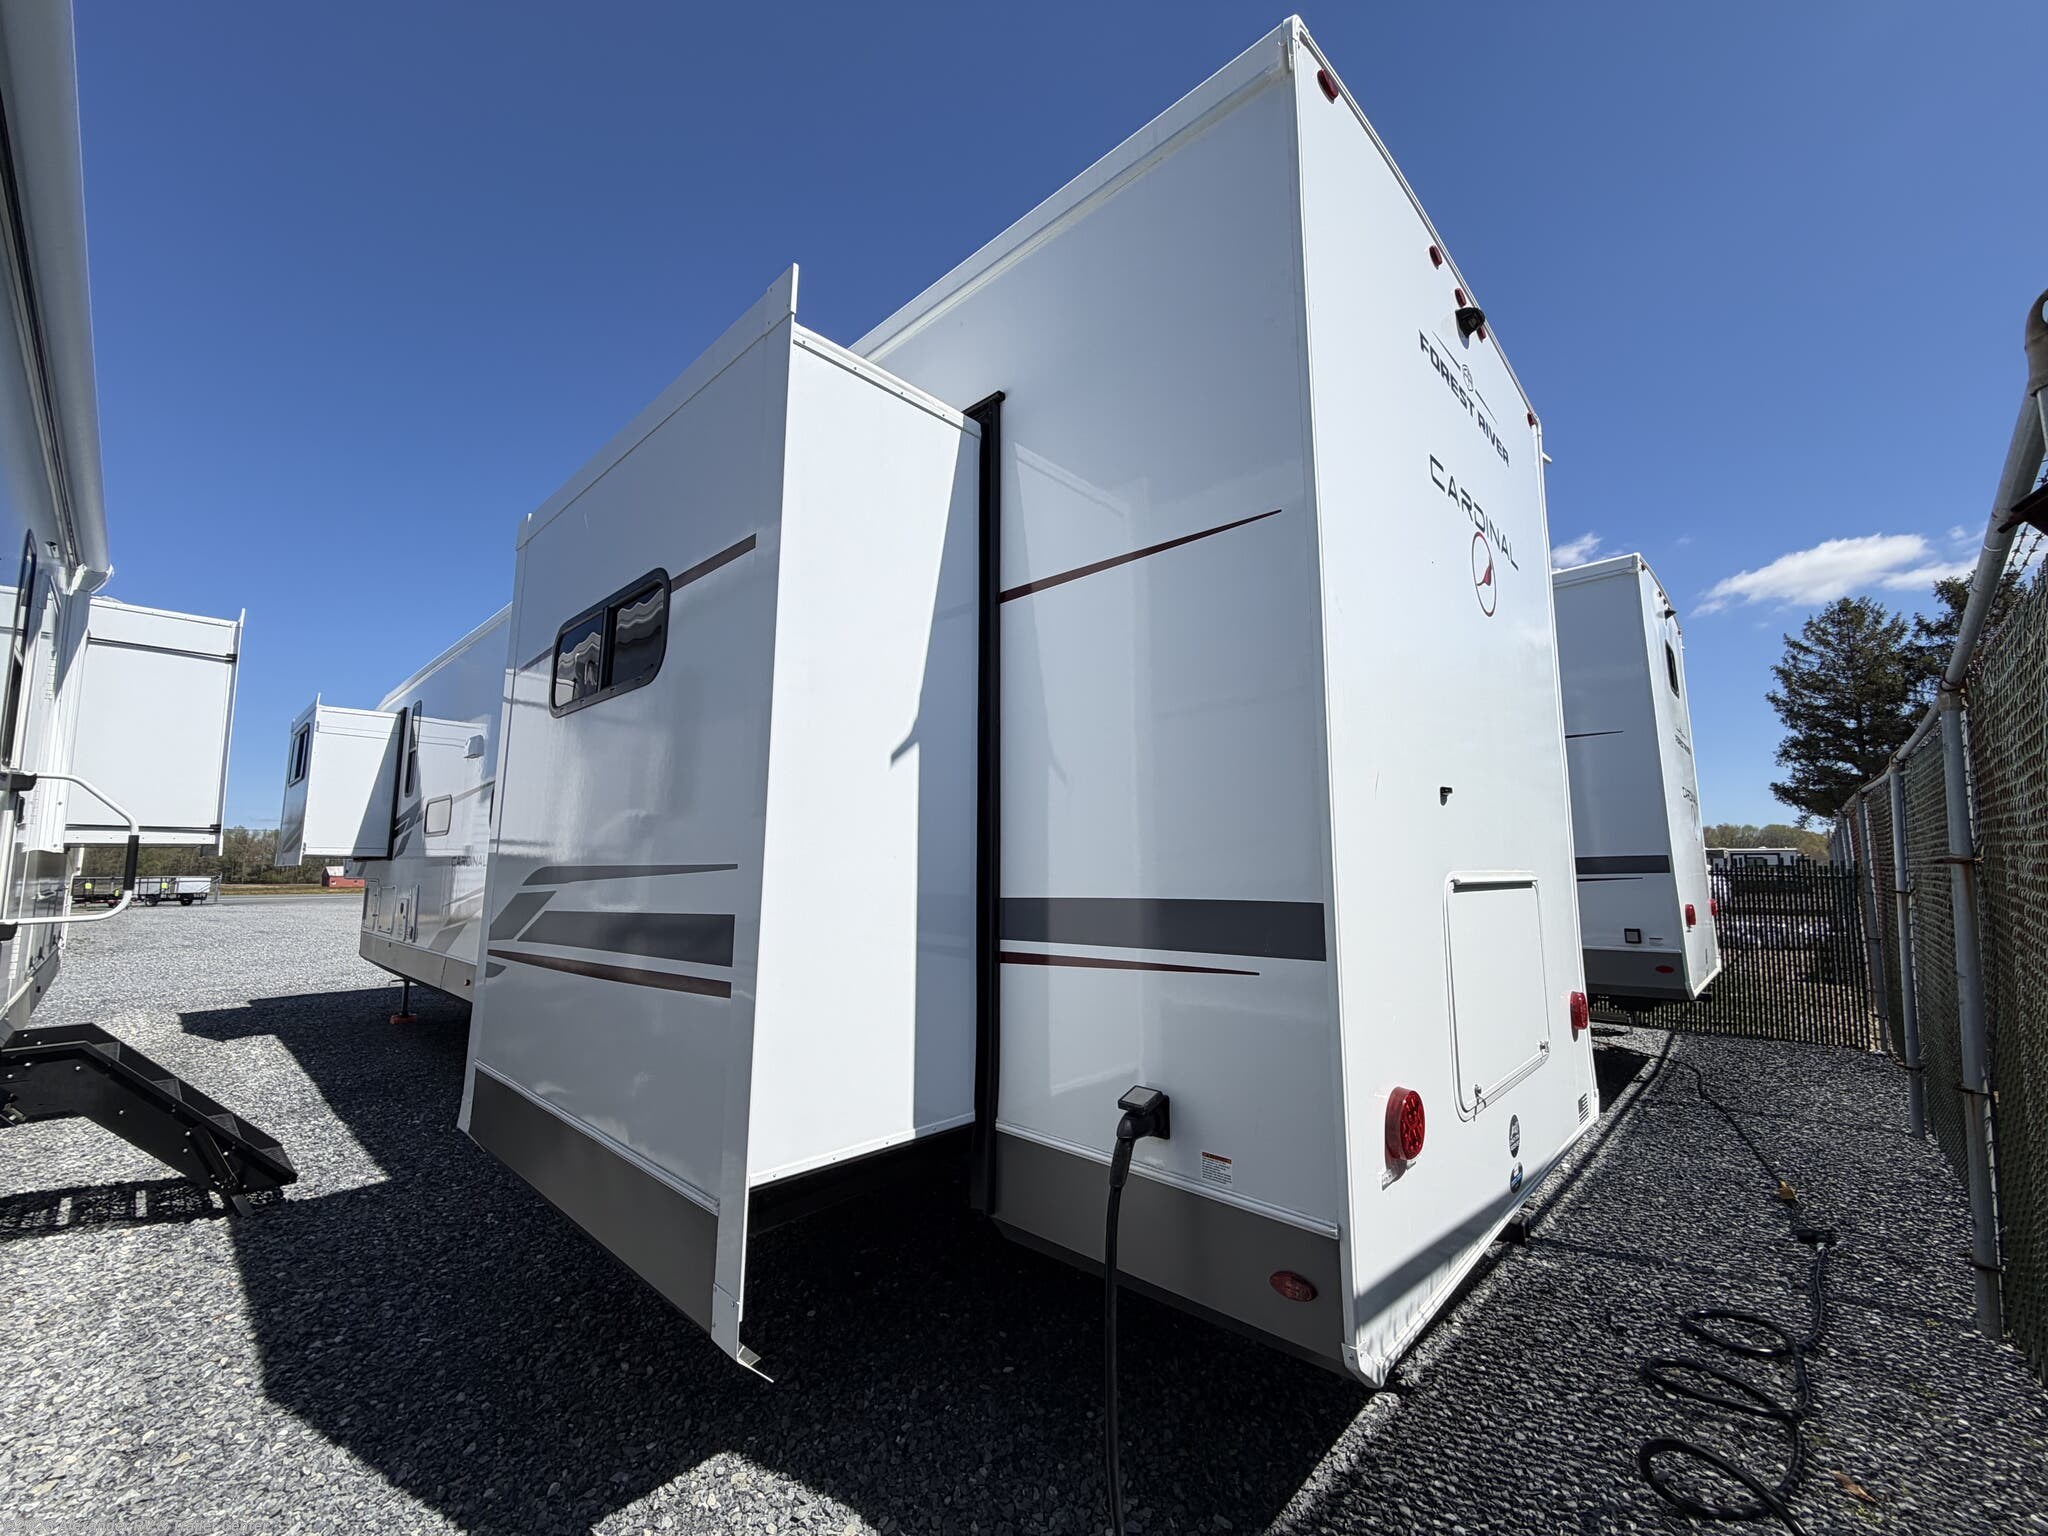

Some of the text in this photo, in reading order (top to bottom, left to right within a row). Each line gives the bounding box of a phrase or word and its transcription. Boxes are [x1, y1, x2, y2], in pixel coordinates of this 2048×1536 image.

[1418, 329, 1510, 468] FOREST RIVER
[1429, 453, 1519, 572] CARDINAL
